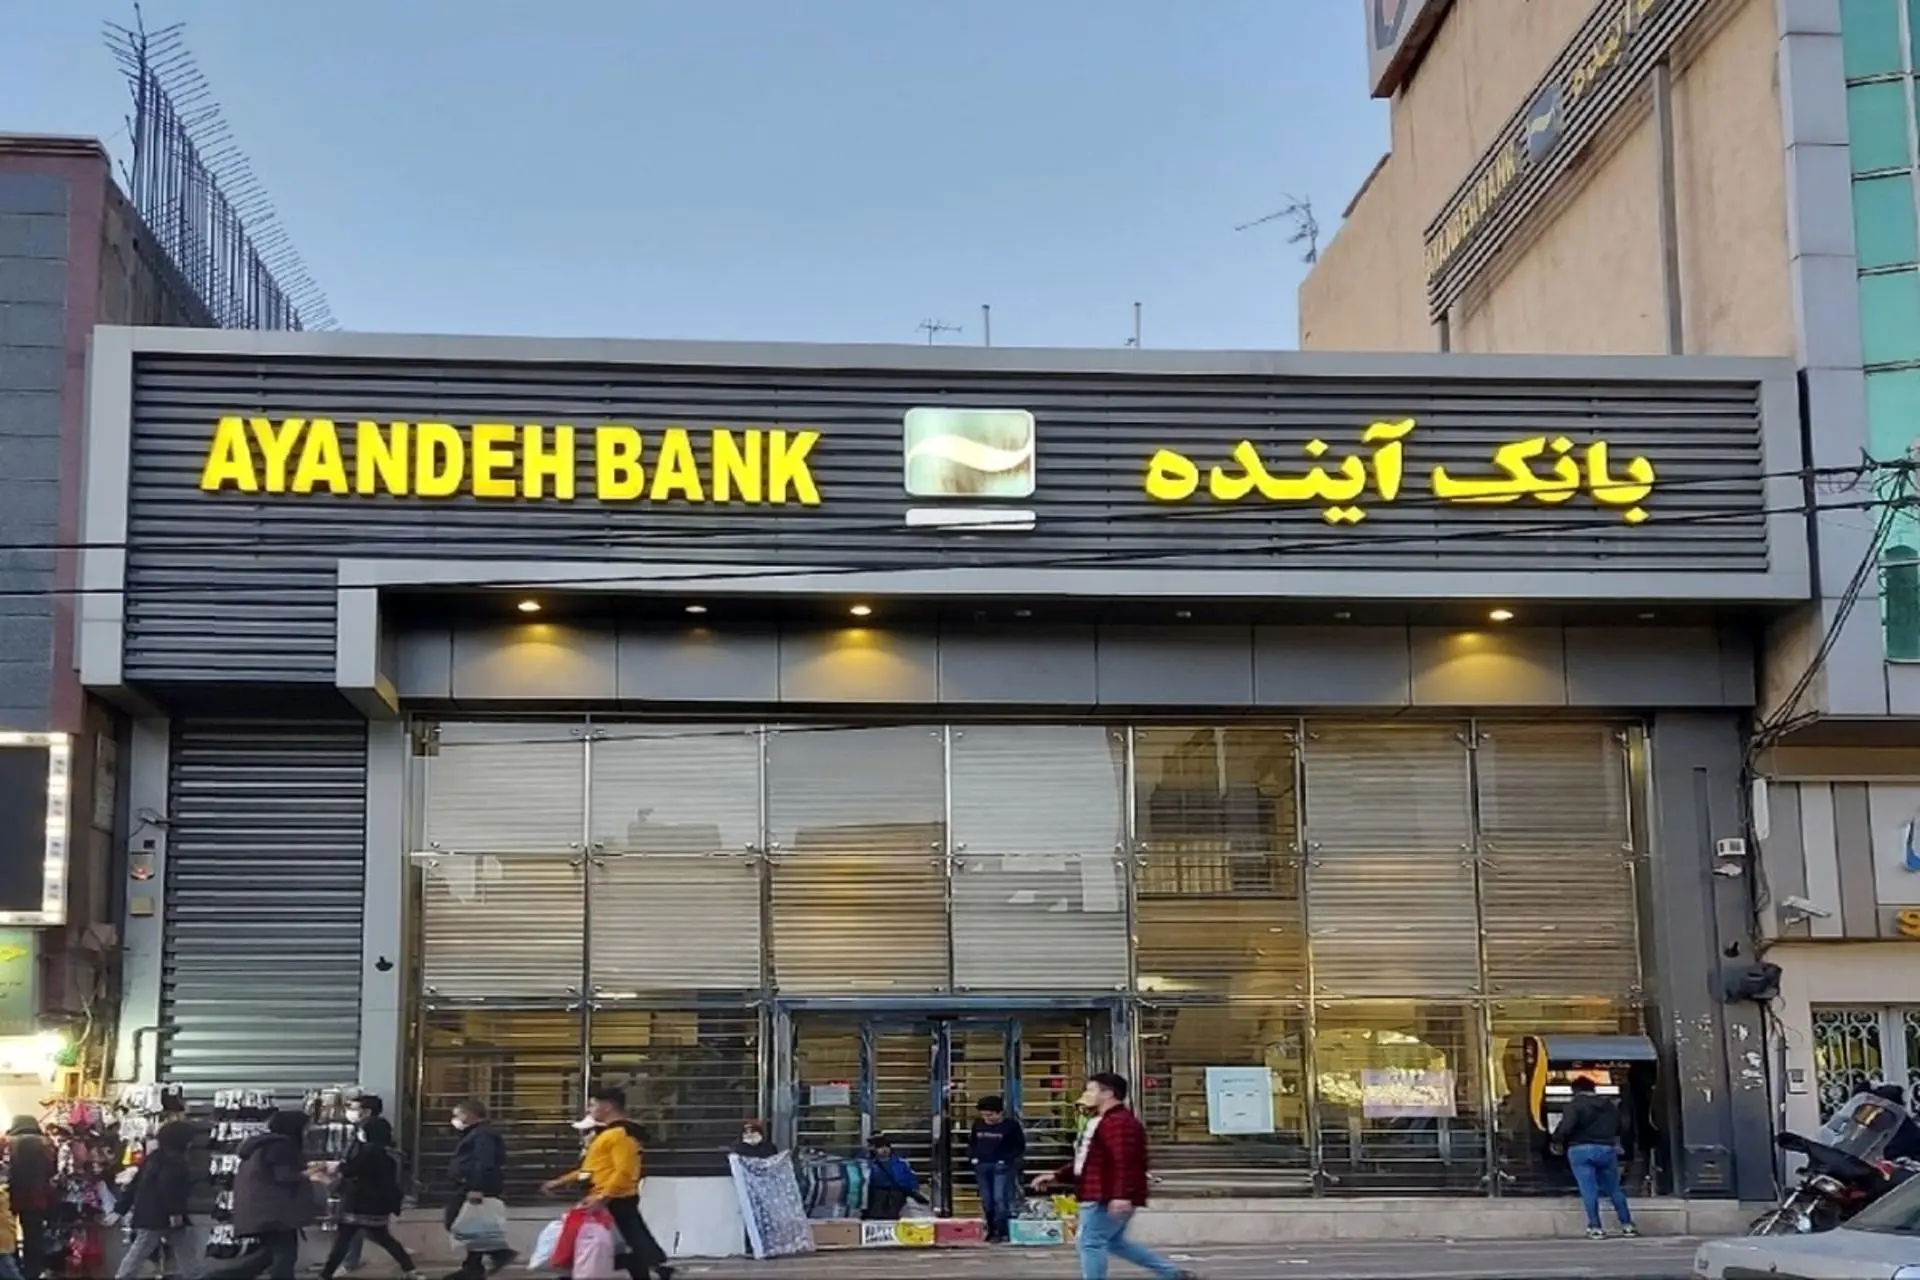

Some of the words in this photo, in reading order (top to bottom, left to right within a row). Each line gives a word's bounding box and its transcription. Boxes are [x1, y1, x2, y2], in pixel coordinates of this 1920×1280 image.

[201, 416, 575, 498] AYANDEH
[595, 425, 821, 504] BANK
[1144, 417, 1416, 524] آینده
[1432, 435, 1654, 524] بانک
